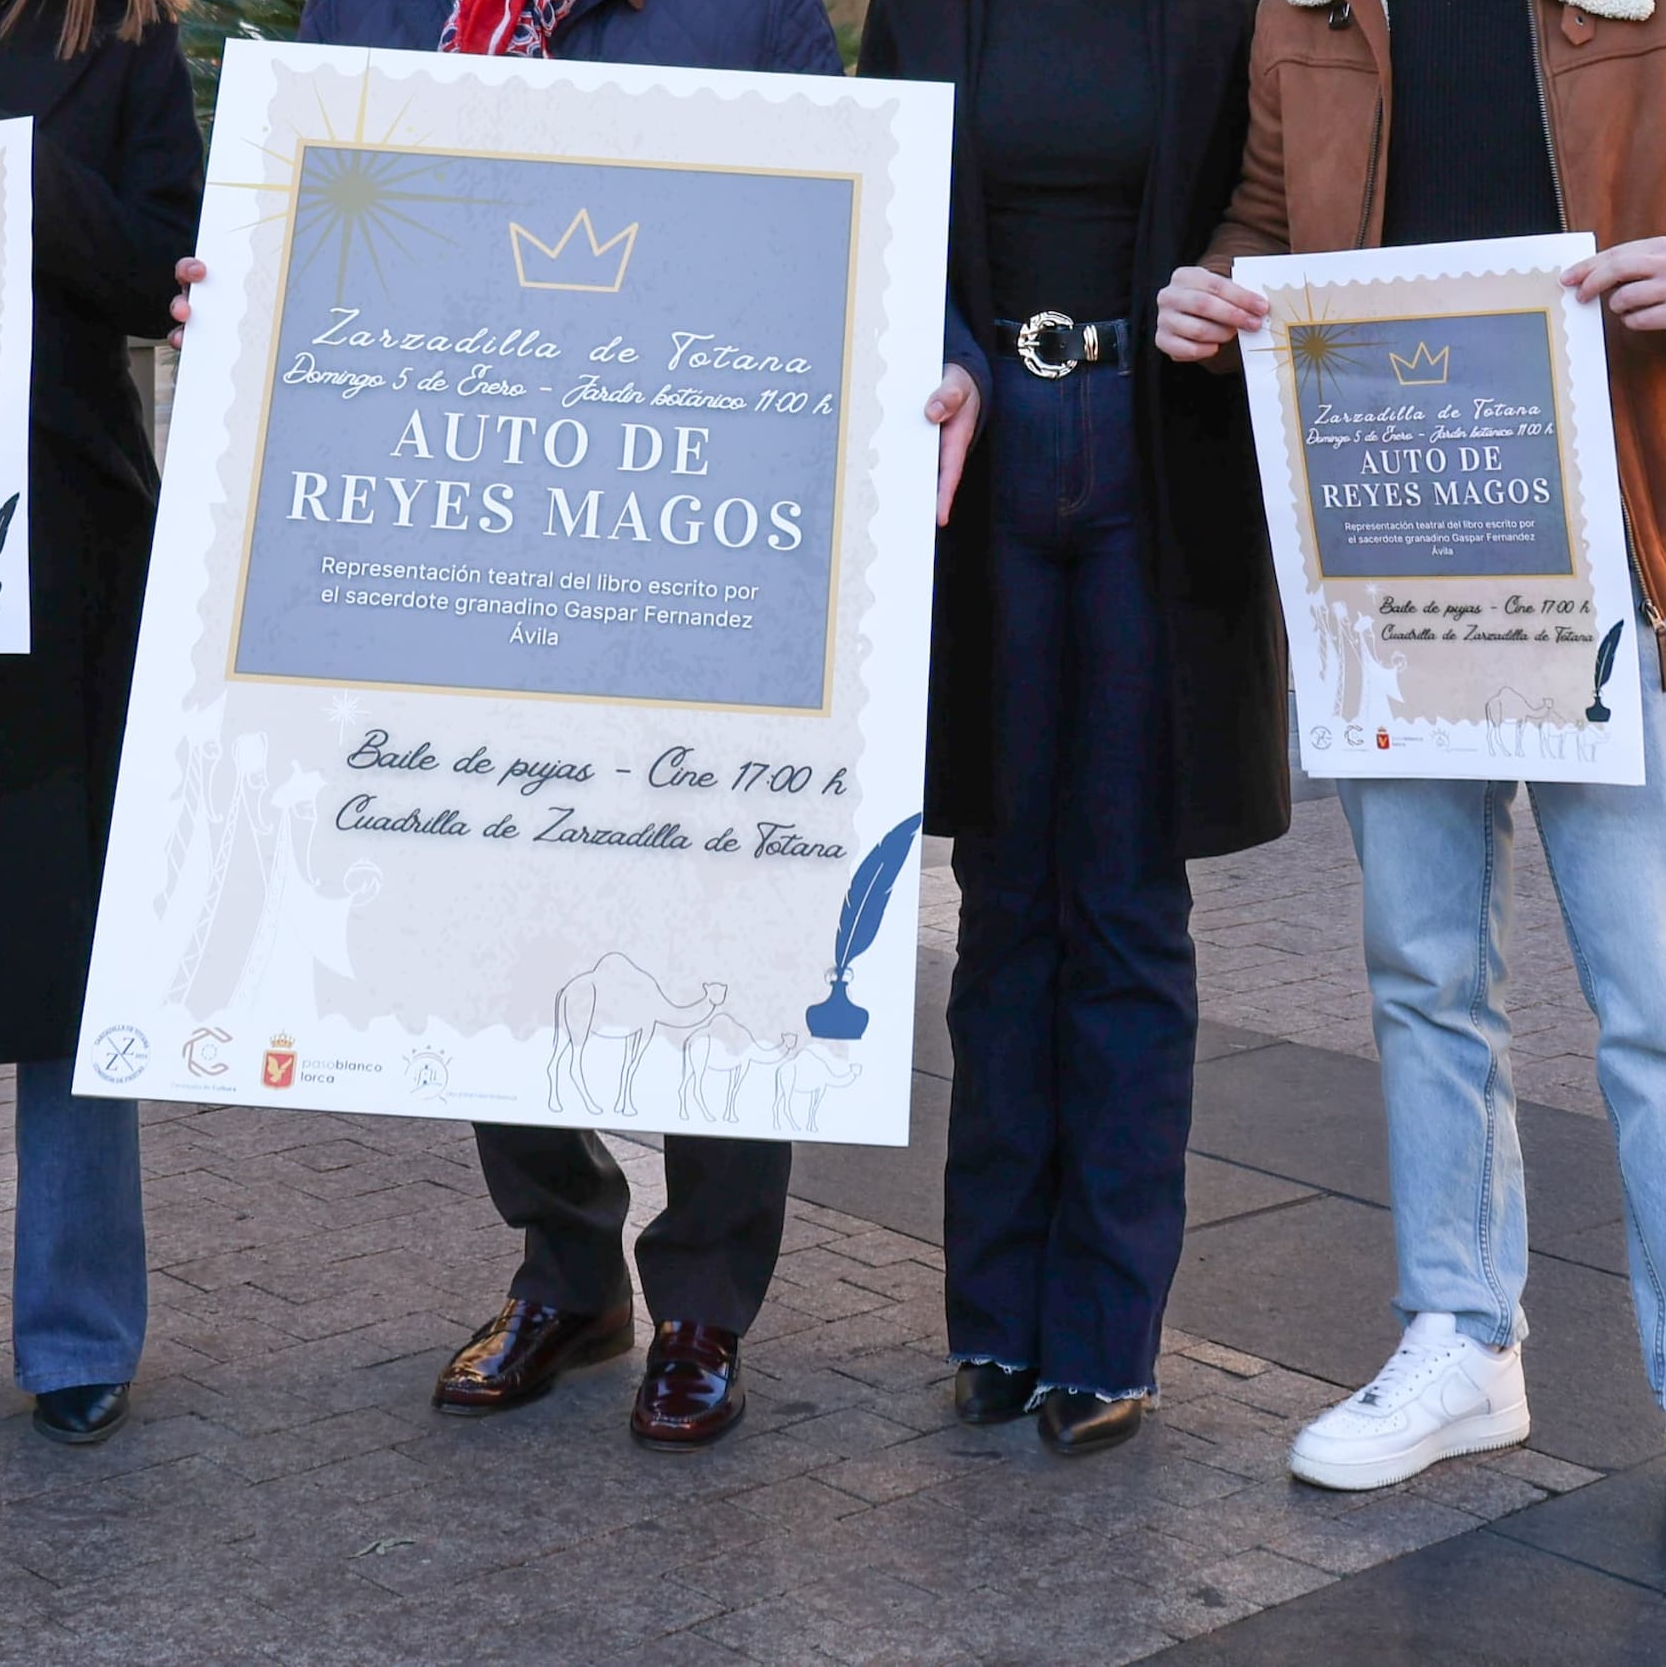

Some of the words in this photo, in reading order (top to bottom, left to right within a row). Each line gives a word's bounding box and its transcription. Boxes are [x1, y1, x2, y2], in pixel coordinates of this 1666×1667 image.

[312, 307, 561, 358] Zarzadilla
[589, 336, 639, 363] de
[668, 331, 812, 373] Totana
[283, 352, 386, 399] Domingo
[393, 367, 414, 390] 5
[417, 370, 449, 391] de
[457, 363, 527, 396] Enero
[650, 384, 747, 410] botánico
[754, 389, 808, 413] 11:00
[812, 393, 833, 415] h
[1314, 404, 1425, 424] Zarzadilla
[1437, 404, 1461, 419] de
[1473, 398, 1541, 420] Totana
[390, 408, 589, 468] AUTO
[617, 423, 710, 475] DE
[1353, 430, 1362, 442] 5
[1364, 431, 1378, 441] de
[1544, 422, 1554, 434] h
[1360, 447, 1446, 475] AUTO
[1460, 446, 1502, 472] DE
[1322, 482, 1421, 508] REYES
[1433, 477, 1551, 506] MAGOS
[286, 470, 514, 534] REYES
[542, 487, 803, 551] MAGOS
[1344, 521, 1414, 531] Representación
[1416, 521, 1445, 530] teatral
[1447, 521, 1461, 529] del
[1463, 520, 1483, 528] libro
[1485, 519, 1517, 528] escrito
[1519, 520, 1535, 530] por
[1348, 535, 1356, 544] el
[1358, 535, 1403, 544] sacerdote
[1405, 534, 1450, 545] granadino
[1452, 534, 1484, 544] Gaspar
[1486, 532, 1535, 541] Fernandez
[320, 556, 481, 584] Representación
[488, 567, 553, 588] teatral
[560, 571, 590, 590] del
[597, 574, 641, 594] libro
[648, 579, 718, 598] escrito
[724, 584, 759, 605] por
[321, 587, 338, 604] el
[345, 589, 448, 610] sacerdote
[455, 596, 558, 617] granadino
[565, 601, 638, 624] Gaspar
[644, 606, 753, 629] Fernandez
[1379, 595, 1417, 614] Baile
[1422, 600, 1441, 614] de
[1443, 603, 1482, 622] pujas
[1504, 595, 1535, 614] Cine
[1579, 599, 1591, 614] h
[509, 621, 559, 646] Ávila
[1380, 623, 1435, 641] Cuadrilla
[1442, 627, 1457, 641] de
[1463, 624, 1528, 642] Zarzadilla
[1533, 627, 1550, 642] de
[1554, 625, 1594, 643] Totana
[347, 729, 439, 770] Baile
[453, 746, 495, 774] de
[497, 758, 595, 796] pujas
[649, 746, 717, 787] Cine
[731, 761, 812, 792] 17:00
[822, 767, 847, 795] h
[335, 794, 471, 835] Cuadrilla
[483, 814, 520, 839] de
[533, 806, 692, 849] Zarzadilla
[705, 828, 741, 852] de
[754, 822, 846, 858] Totana
[301, 1072, 334, 1083] lorca
